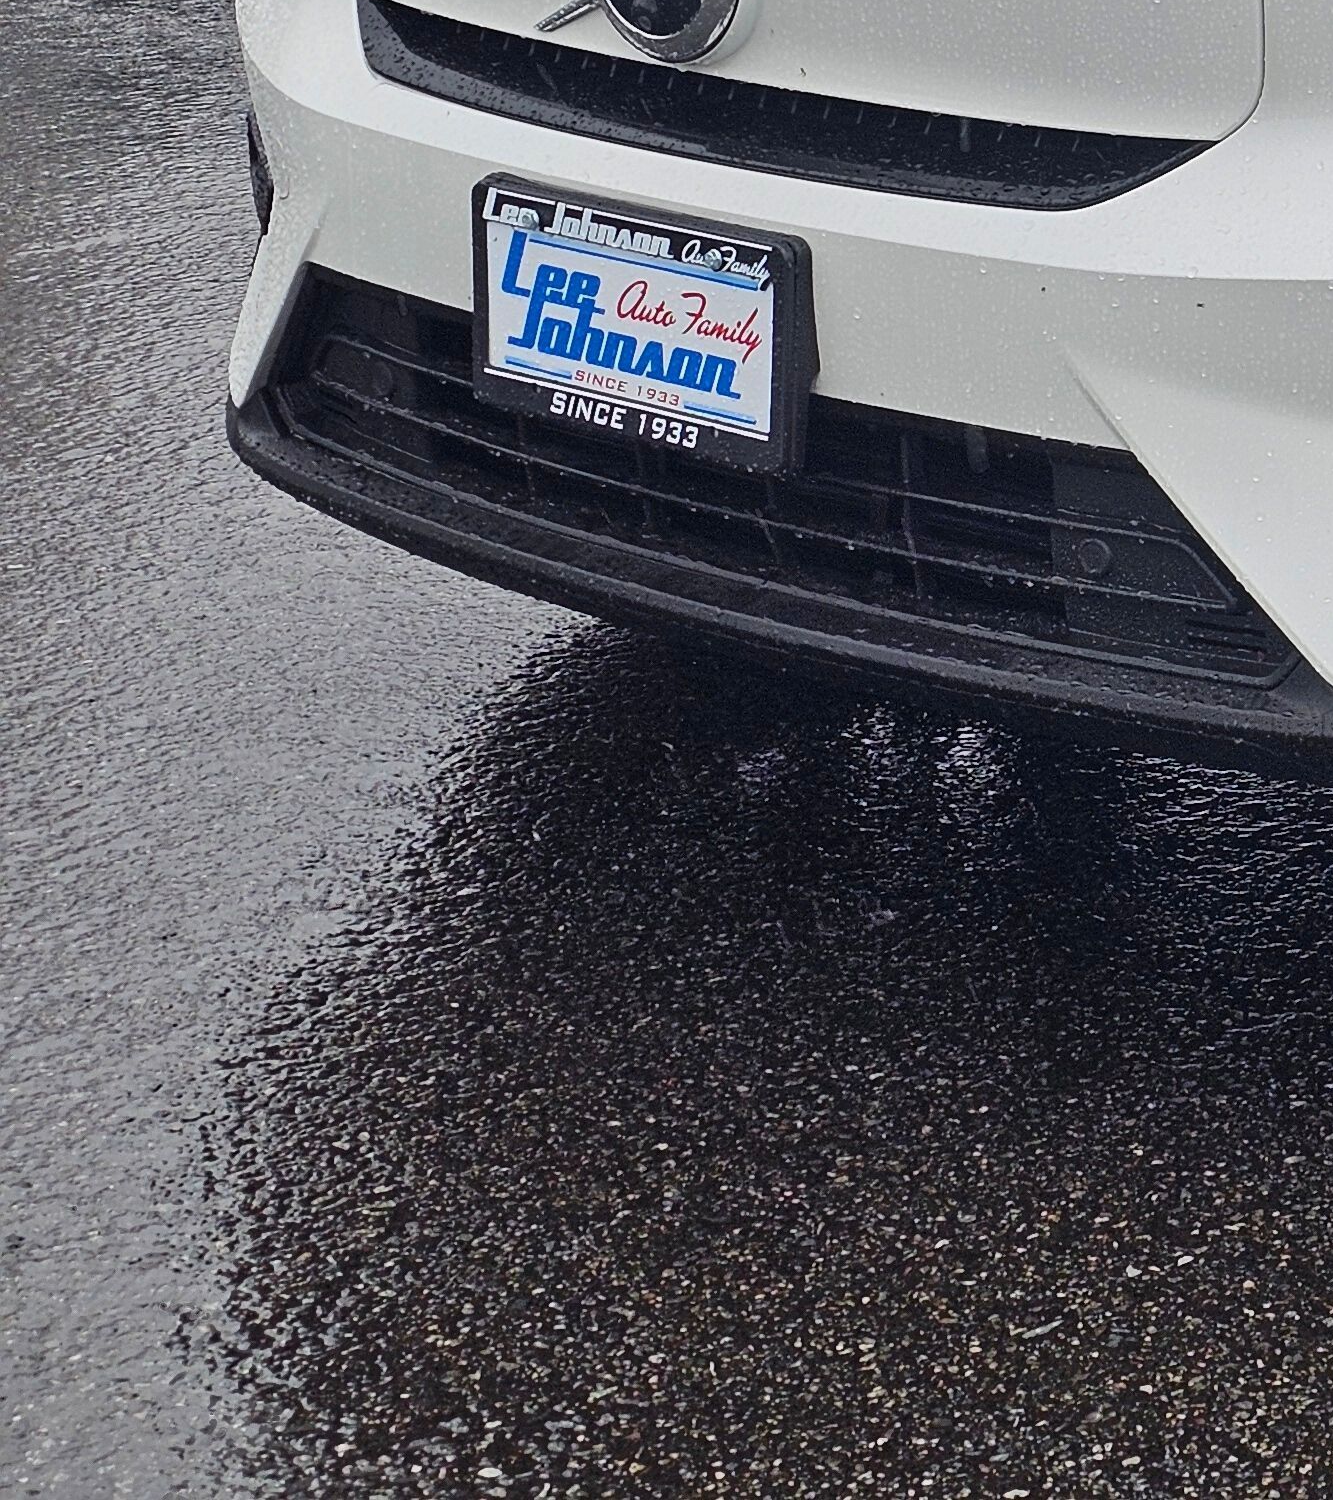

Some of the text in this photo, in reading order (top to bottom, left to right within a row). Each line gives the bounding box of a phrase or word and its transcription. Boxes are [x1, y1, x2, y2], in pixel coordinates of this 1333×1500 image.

[543, 201, 674, 260] Johnson
[719, 245, 771, 291] Family
[501, 228, 763, 364] Lee Auto Family
[507, 298, 742, 400] Johnson
[573, 369, 681, 407] SINCE 1933
[550, 392, 700, 449] SINCE 1933
